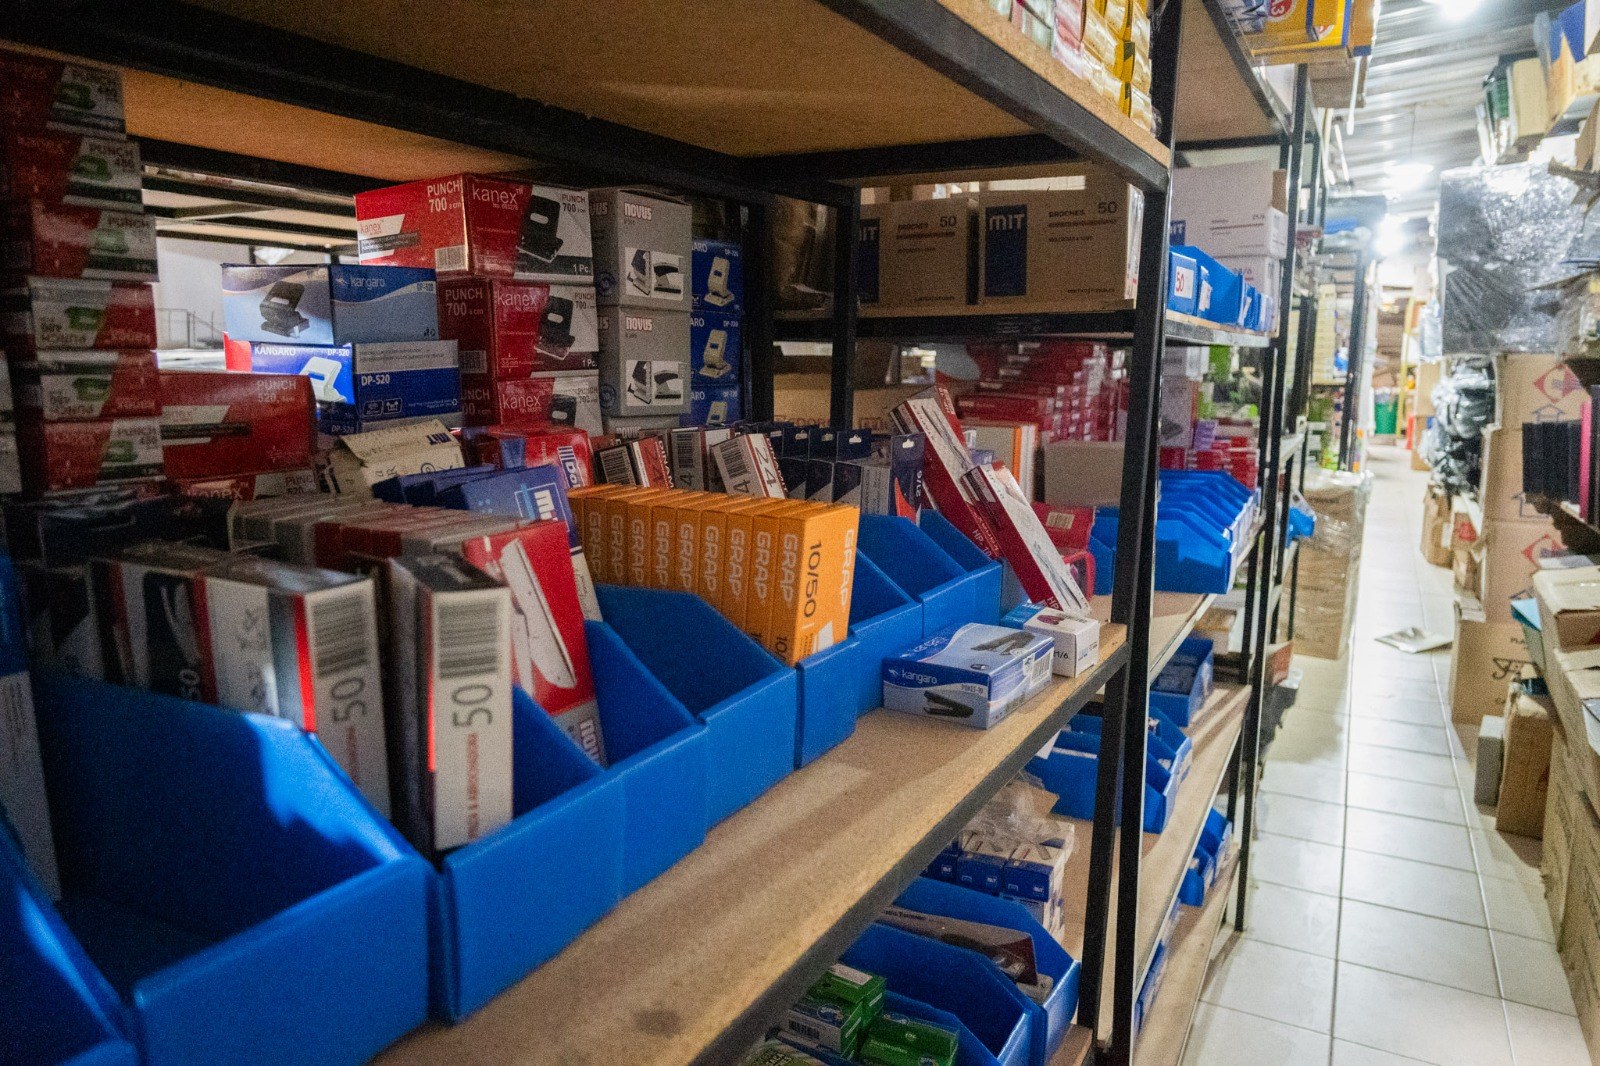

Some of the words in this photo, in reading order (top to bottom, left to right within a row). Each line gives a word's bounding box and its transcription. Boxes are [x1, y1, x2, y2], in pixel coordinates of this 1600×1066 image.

[427, 179, 462, 195] PUNCH
[472, 183, 517, 204] kanex
[429, 198, 447, 213] 700
[561, 193, 586, 203] PUNCH
[562, 203, 576, 212] 700
[1097, 201, 1117, 214] 50
[940, 216, 957, 227] 50
[350, 276, 386, 291] kangaro
[1175, 272, 1185, 293] 50
[445, 288, 483, 301] PUNCH
[496, 290, 537, 307] kanex
[574, 292, 595, 301] PUNCH
[446, 303, 467, 316] 700
[254, 346, 296, 357] KANGARO
[327, 347, 350, 357] DP-520
[256, 379, 297, 391] PUNCH
[361, 373, 391, 386] DP-520
[502, 393, 541, 409] kanex
[655, 520, 671, 587] GRAP
[679, 523, 695, 590] GRAP
[704, 525, 720, 592] GRAP
[729, 528, 746, 597] GRAP
[754, 530, 772, 600] GRAP
[781, 533, 798, 602] GRAP
[840, 528, 856, 607] GRAP
[803, 539, 823, 619] 10/50
[902, 669, 938, 684] kangaro
[331, 677, 367, 724] 50
[451, 683, 493, 729] 50
[580, 719, 604, 766] nov
